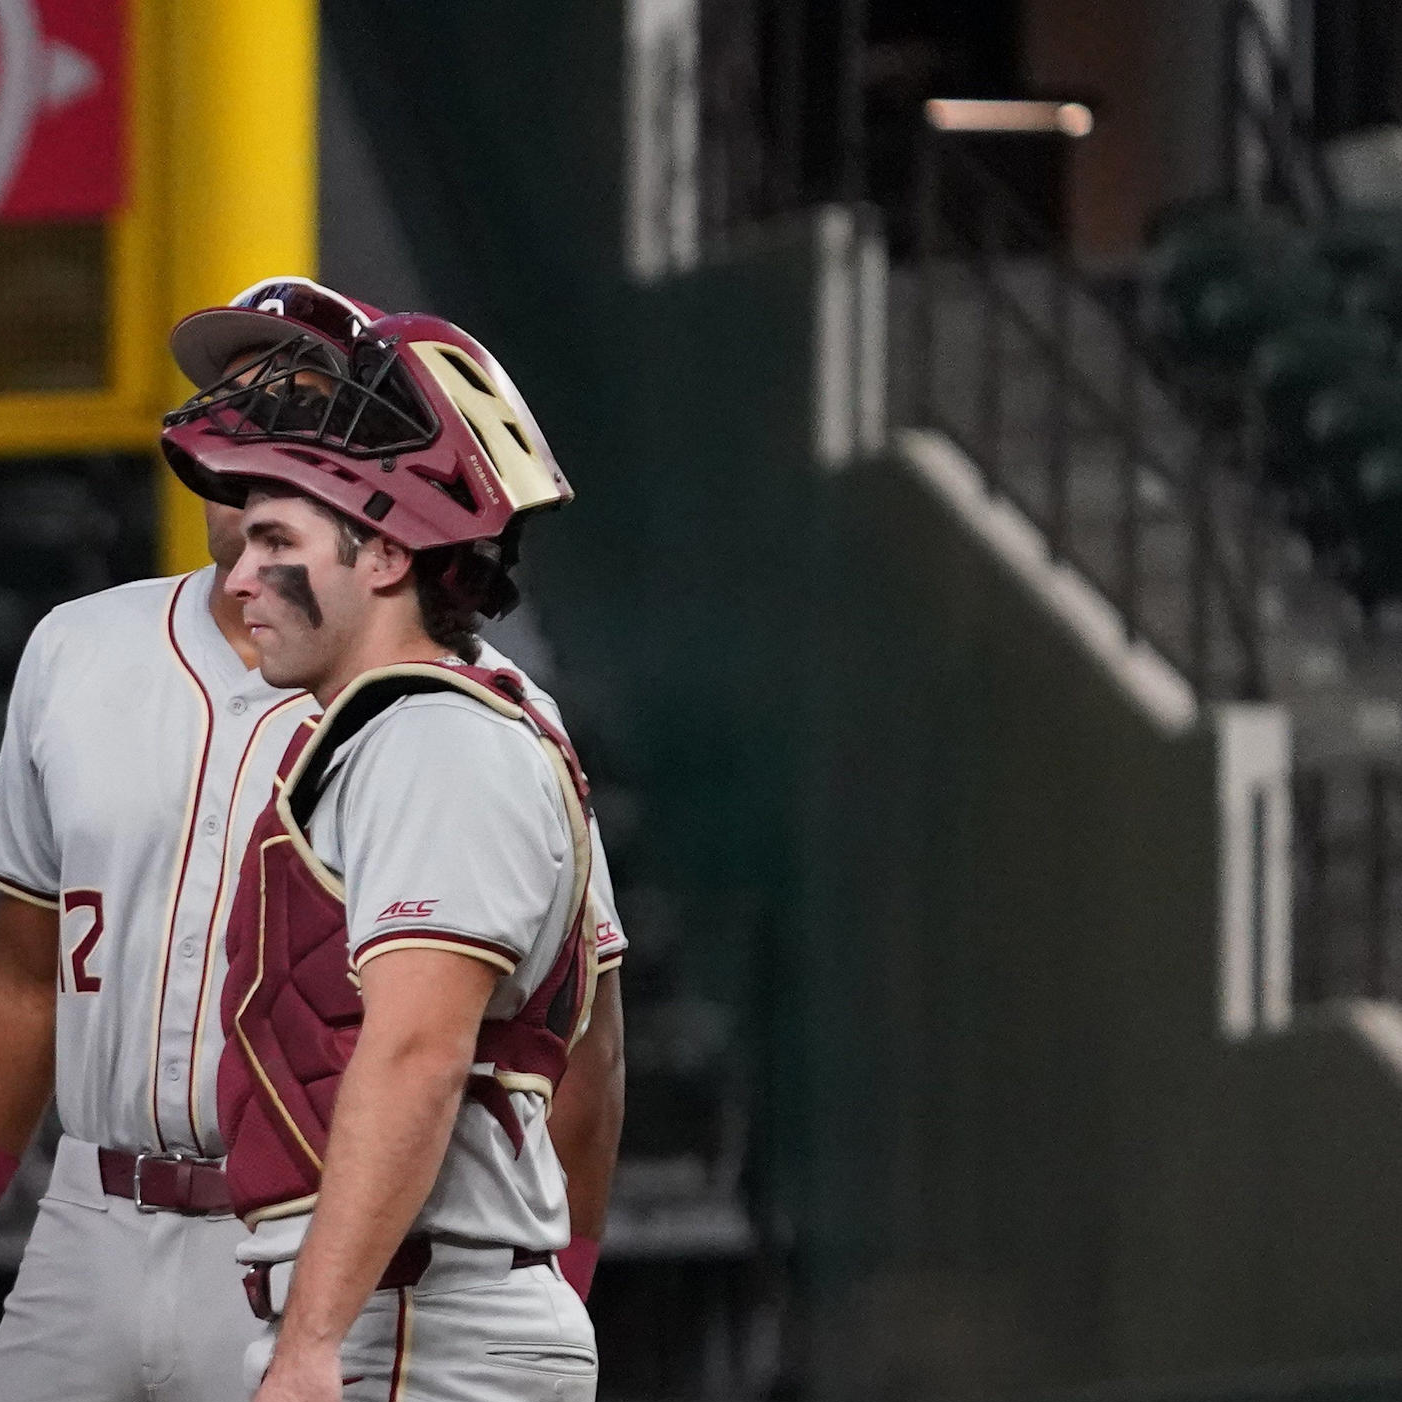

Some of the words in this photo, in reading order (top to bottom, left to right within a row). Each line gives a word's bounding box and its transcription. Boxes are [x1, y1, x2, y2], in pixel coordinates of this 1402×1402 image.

[469, 454, 500, 505] EVOSHIELD
[375, 899, 440, 923] ACC
[59, 886, 105, 995] 2
[596, 920, 618, 947] CC
